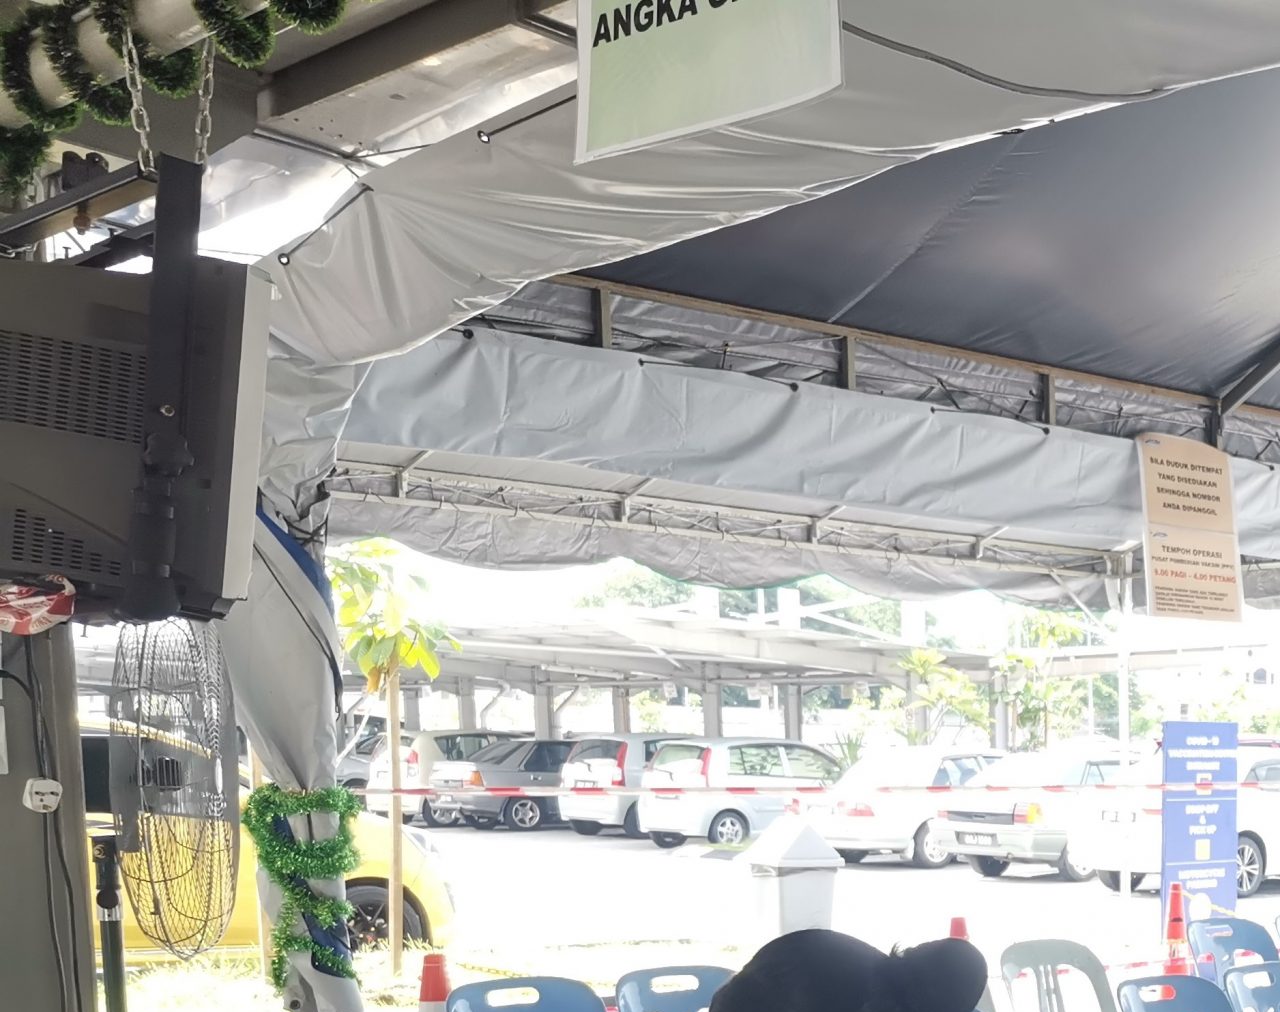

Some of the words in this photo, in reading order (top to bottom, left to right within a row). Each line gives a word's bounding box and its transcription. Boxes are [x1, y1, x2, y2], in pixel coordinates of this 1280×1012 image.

[593, 0, 698, 47] ANGKA
[1149, 456, 1165, 466] BILA
[1166, 459, 1190, 471] DUDUK
[1190, 463, 1223, 476] DITEMPAT
[1157, 472, 1176, 483] YANG
[1177, 475, 1218, 488] DISEDIAKAN
[1156, 486, 1191, 499] SEHINGGA
[1192, 491, 1221, 503] NOMBOR
[1162, 502, 1181, 512] ANDA
[1182, 504, 1218, 516] DIPANGGIL
[1161, 545, 1192, 557] TEMPOH
[1192, 548, 1223, 559] OPERASI
[1170, 569, 1187, 579] PAGI
[1209, 573, 1237, 584] PETANG
